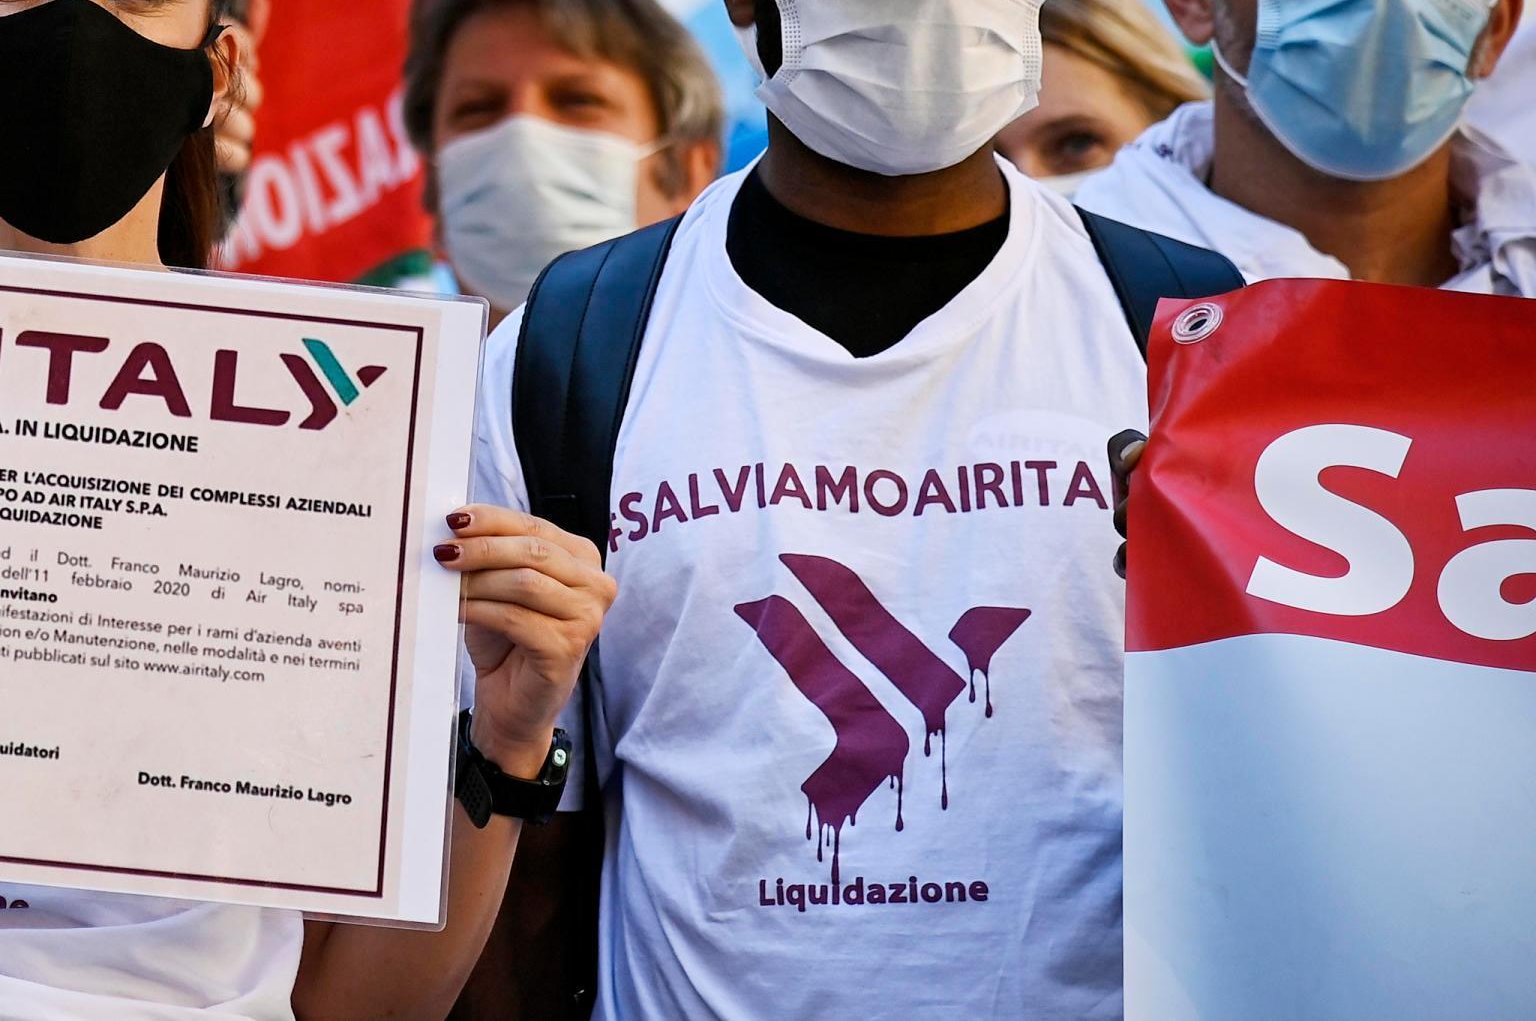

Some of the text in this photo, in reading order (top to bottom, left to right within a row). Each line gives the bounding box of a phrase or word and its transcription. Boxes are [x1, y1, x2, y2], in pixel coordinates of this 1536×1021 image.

[14, 417, 39, 438] IN
[42, 420, 200, 454] LIQUIDAZIONE
[20, 489, 46, 505] AD
[47, 491, 77, 509] AIR
[79, 494, 124, 513] ITALY
[124, 498, 169, 518] S.P.A.
[22, 470, 152, 497] L'ACQUISIZIONE
[156, 482, 185, 500] DEI
[188, 486, 281, 510] COMPLESSI
[284, 496, 372, 518] AZIENDALI
[1245, 423, 1536, 641] Sa
[0, 564, 49, 583] dell'11
[70, 570, 133, 592] febbraio
[152, 578, 191, 598] 2020
[209, 584, 226, 600] di
[244, 588, 268, 604] Air
[286, 592, 319, 613] Italy
[337, 601, 365, 617] spa
[29, 547, 39, 563] il
[55, 550, 92, 568] Dott.
[109, 555, 161, 575] Franco
[177, 562, 241, 584] Maurizio
[258, 570, 305, 591] Lagro,
[322, 580, 366, 594] nomi-
[23, 626, 51, 642] e/o
[52, 627, 160, 654] Manutenzione,
[162, 640, 199, 656] nelle
[201, 644, 267, 663] modalità
[268, 652, 280, 665] e
[282, 654, 306, 667] nei
[307, 654, 361, 671] termini
[77, 611, 93, 627] di
[96, 613, 163, 634] Interesse
[166, 623, 193, 638] per
[196, 626, 202, 637] i
[205, 627, 239, 641] rami
[242, 627, 313, 649] d'azienda
[316, 638, 362, 653] aventi
[12, 645, 87, 665] pubblicati
[89, 652, 112, 668] sul
[113, 657, 141, 671] sito
[142, 661, 266, 683] www.airitaly.com
[136, 770, 353, 808] Dott. Franco Maurizio Lagro
[759, 875, 989, 912] Liquidazione
